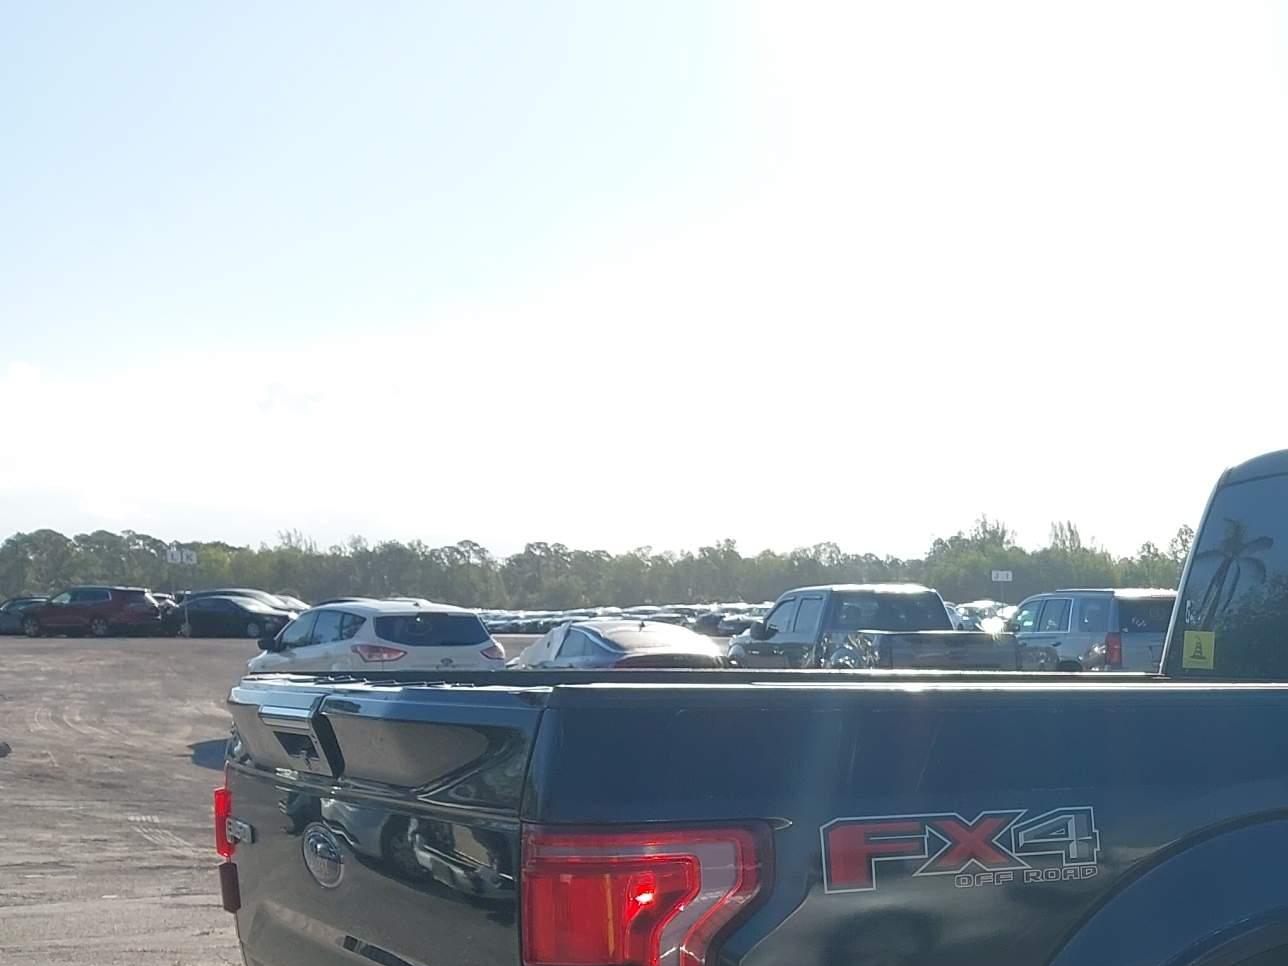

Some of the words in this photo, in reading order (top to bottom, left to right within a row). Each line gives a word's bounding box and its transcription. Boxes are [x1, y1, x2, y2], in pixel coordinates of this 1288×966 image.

[819, 807, 1100, 894] FX4
[953, 870, 1014, 889] OFF
[1022, 864, 1099, 884] ROAD
